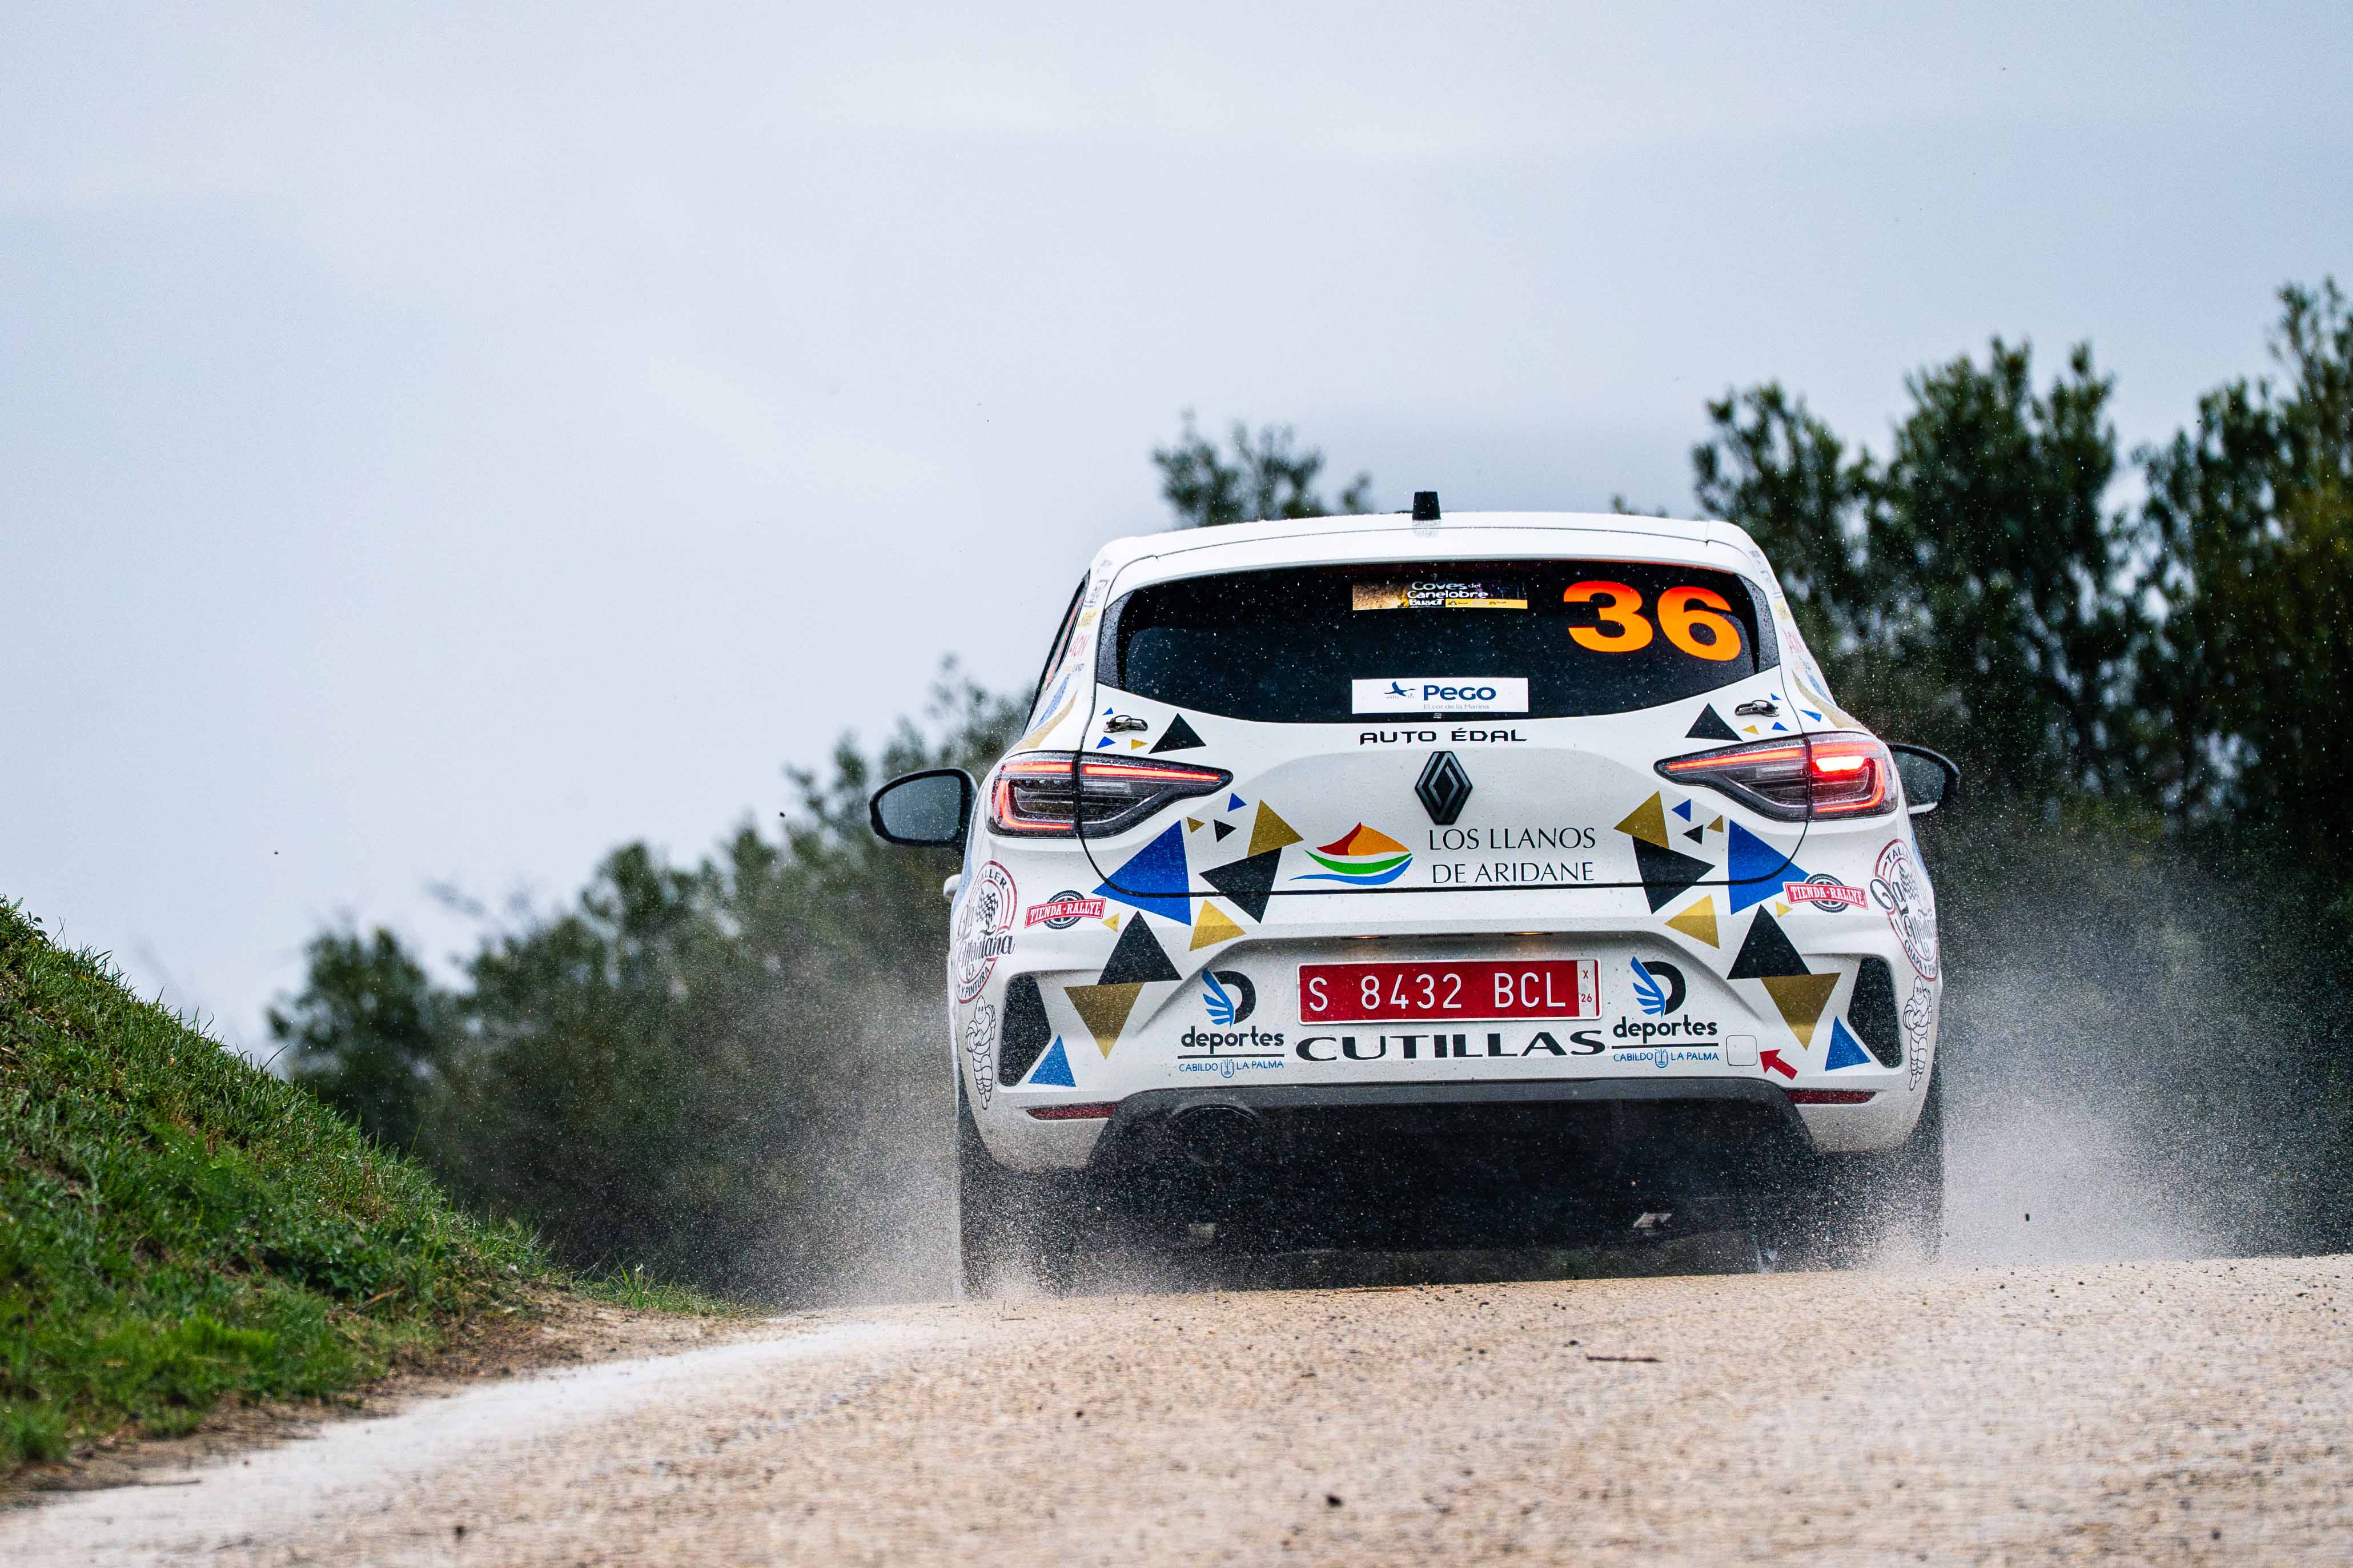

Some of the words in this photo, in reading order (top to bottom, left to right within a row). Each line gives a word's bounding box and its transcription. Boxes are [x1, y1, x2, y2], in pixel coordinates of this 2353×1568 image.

[1563, 580, 1741, 661] 36
[1360, 731, 1437, 745] AUTO
[1451, 727, 1528, 742] ÉDAL
[1429, 829, 1479, 850] LOS
[1490, 827, 1596, 849] LLANOS
[1432, 864, 1466, 883] DE
[1475, 862, 1594, 882] ARIDANE
[1790, 886, 1827, 900] TIENDA
[1829, 888, 1864, 904] RALLYE
[1030, 904, 1062, 923] TIENDA
[1066, 902, 1102, 915] RALLYE
[965, 966, 990, 998] PINTURA
[1583, 970, 1589, 979] X
[1308, 977, 1328, 1011] S
[1361, 973, 1461, 1010] 8432
[1494, 972, 1566, 1008] BCL
[1581, 993, 1592, 1003] 26
[1613, 1014, 1718, 1044] deportes
[1181, 1026, 1284, 1054] deportes
[1296, 1030, 1605, 1061] CUTILLAS
[1179, 1063, 1218, 1072] CABILDO
[1613, 1052, 1653, 1062] CABILDO
